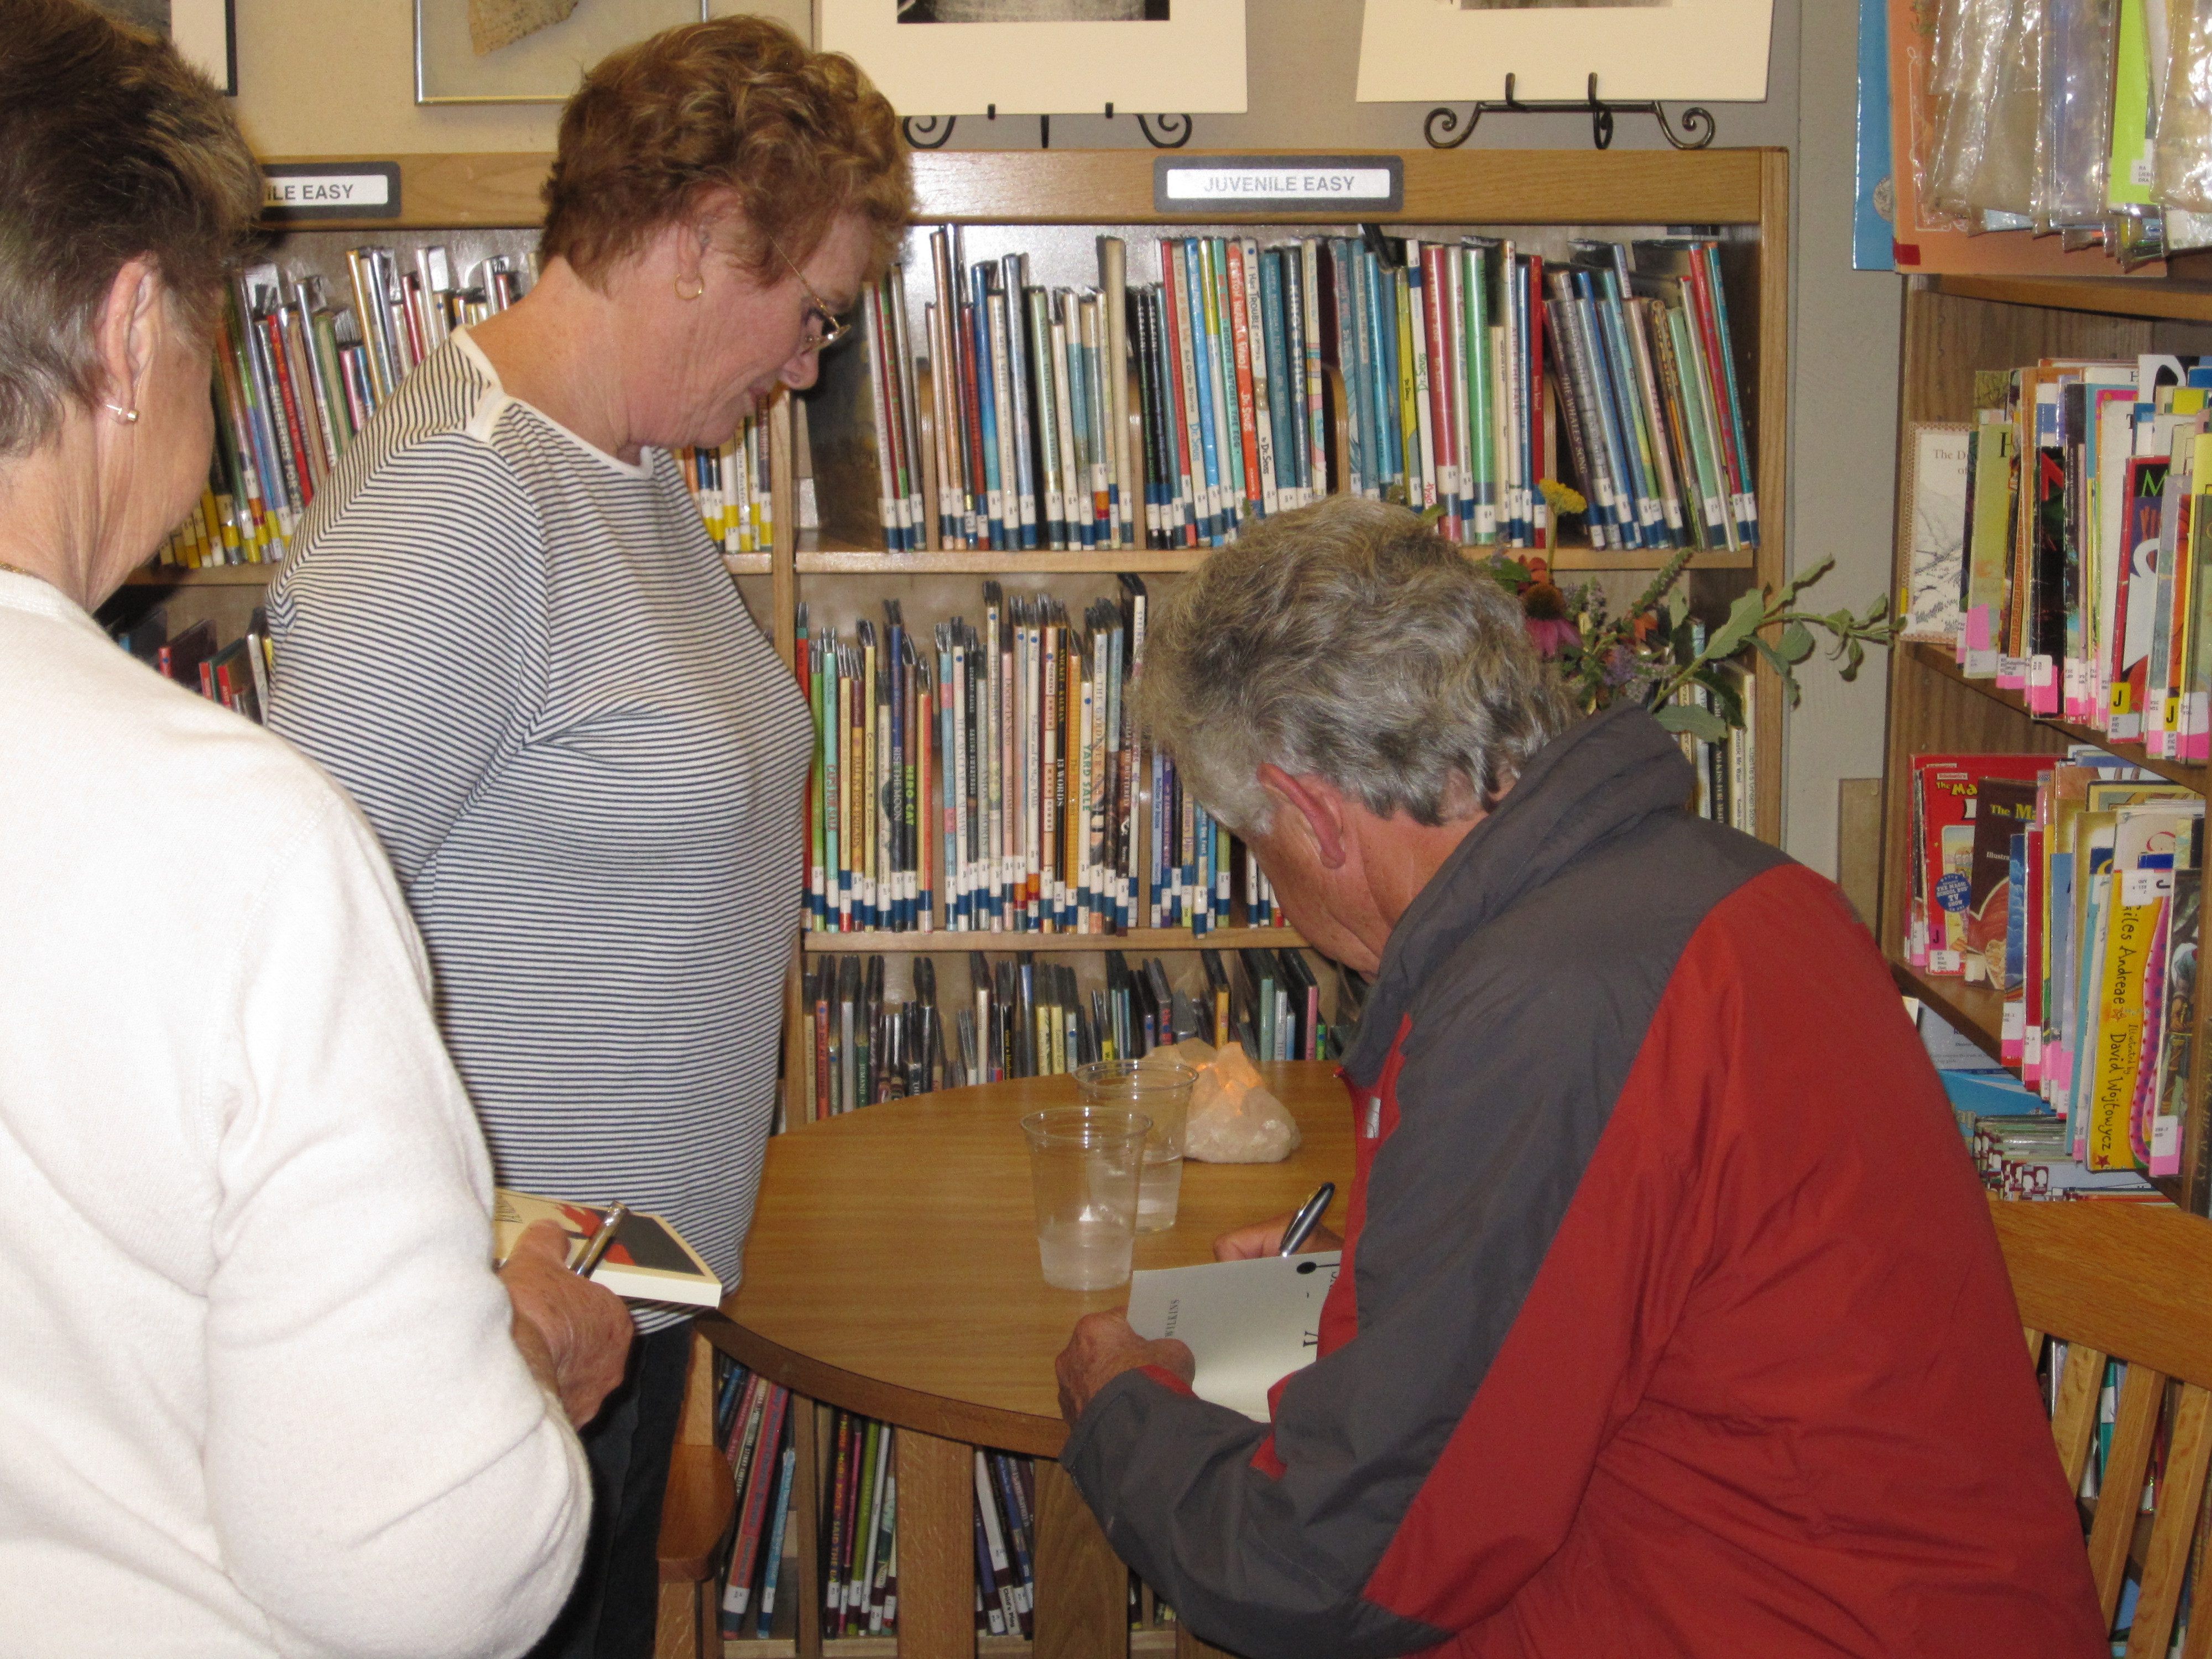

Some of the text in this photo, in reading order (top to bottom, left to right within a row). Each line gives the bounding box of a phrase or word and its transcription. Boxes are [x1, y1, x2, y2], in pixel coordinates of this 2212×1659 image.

[302, 184, 354, 200] EASY
[1204, 176, 1355, 192] JUVENILE EASY
[1249, 291, 1261, 329] TROUBLE
[1292, 347, 1305, 403] STILTS
[1416, 353, 1427, 377] Seuss
[1222, 326, 1240, 447] HORTON HATCHES THE EGG
[270, 385, 292, 460] BLUEBERRIES
[285, 464, 299, 489] FOR
[1188, 422, 1200, 437] Dr.
[1191, 437, 1202, 461] Seuss
[1260, 444, 1270, 455] Dr.
[1575, 446, 1588, 474] SONG
[1934, 449, 1953, 460] The
[1261, 455, 1272, 474] Seuss
[2113, 690, 2122, 707] J
[2166, 706, 2174, 723] J
[1056, 758, 1065, 768] 13
[1082, 744, 1091, 812] YARD SALE
[827, 764, 836, 832] CAPS FOR SALE
[905, 765, 914, 825] HERO CAT
[1990, 804, 2011, 816] The
[1936, 889, 1956, 897] SCHOOL
[1933, 930, 1939, 943] J
[2113, 945, 2137, 1004] Andreae
[2126, 1024, 2140, 1065] Illustrated
[2099, 1033, 2127, 1151] David Wojtowycz
[1165, 1299, 1180, 1338] WILKINS
[832, 1521, 841, 1544] SAID
[831, 1547, 839, 1567] THE
[1003, 1588, 1016, 1628] Child's Play
